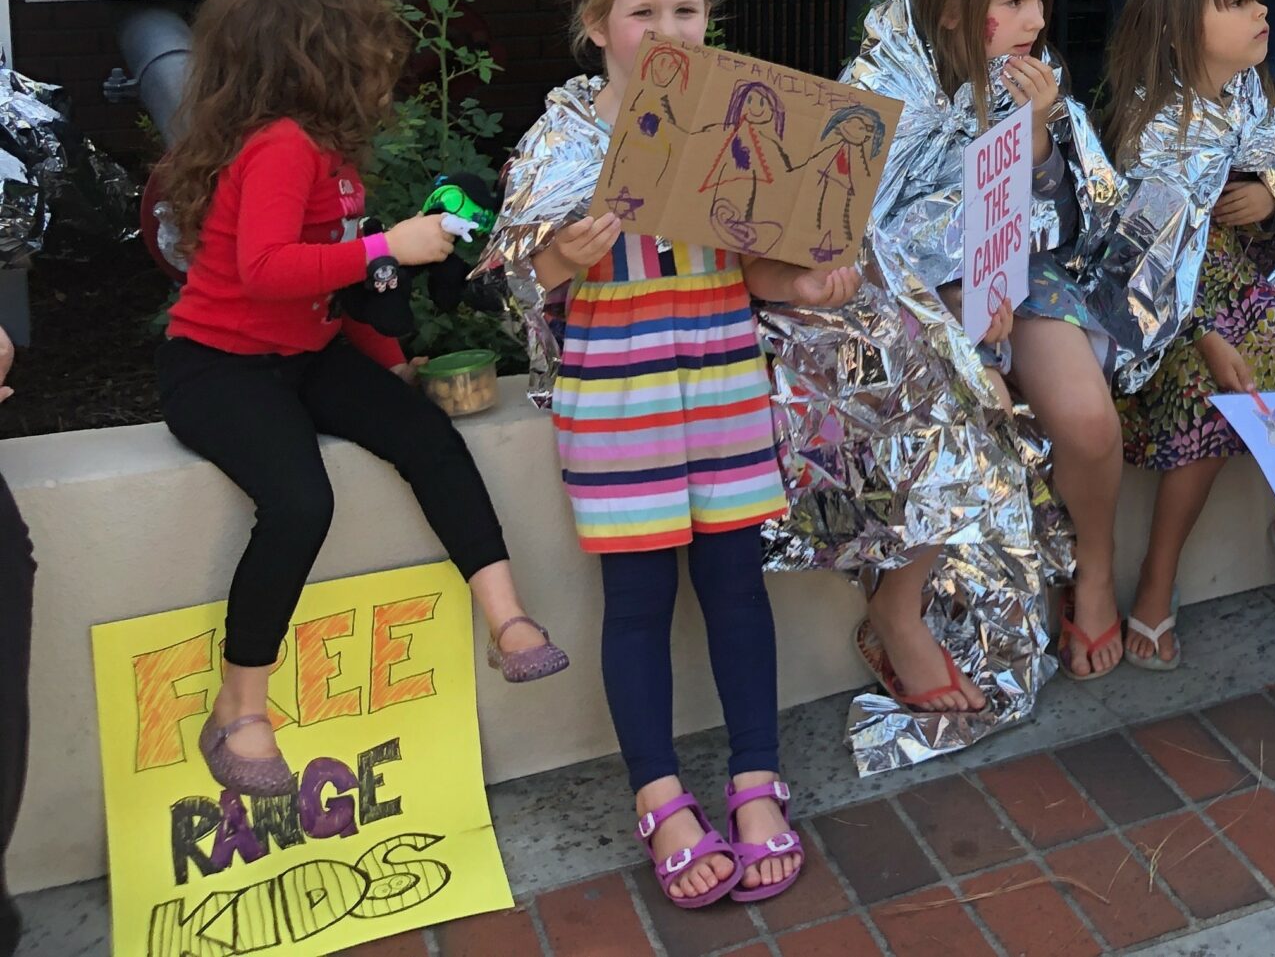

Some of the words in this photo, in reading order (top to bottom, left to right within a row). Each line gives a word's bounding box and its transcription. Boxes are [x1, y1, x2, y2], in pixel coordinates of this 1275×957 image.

[976, 122, 1022, 191] CLOSE
[984, 176, 1011, 232] THE
[972, 213, 1022, 288] CAMPS
[169, 736, 403, 886] RANGE
[147, 832, 452, 957] KIDS
